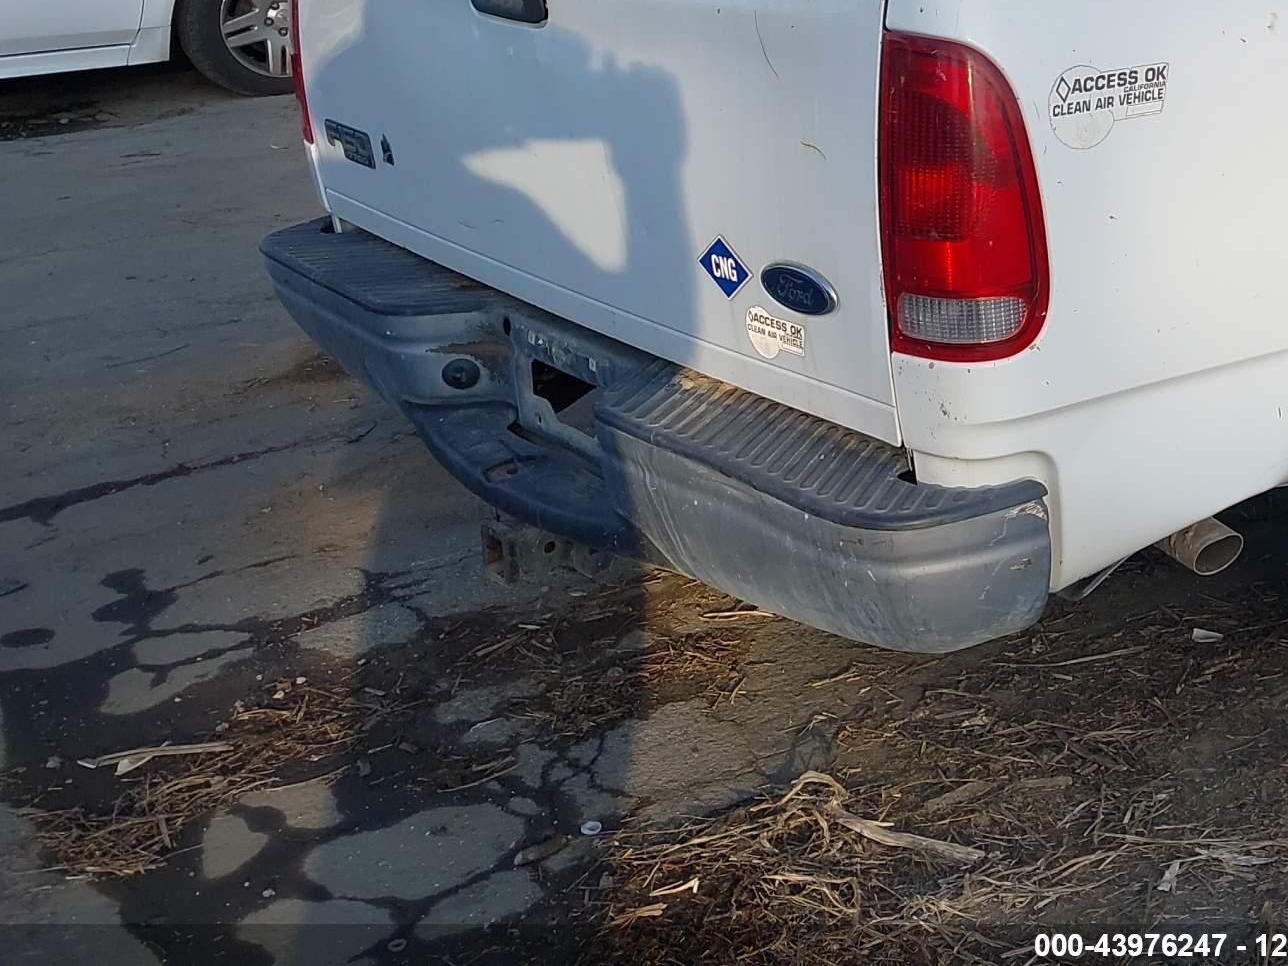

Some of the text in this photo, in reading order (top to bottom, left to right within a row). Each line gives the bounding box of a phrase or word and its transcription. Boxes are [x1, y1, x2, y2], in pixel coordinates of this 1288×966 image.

[1071, 65, 1167, 94] ACCESS OK
[1123, 80, 1166, 93] CALIFORNIA
[1052, 88, 1164, 117] CLEAN AIR VEHICLE
[711, 253, 738, 282] CNG
[775, 273, 815, 306] Ford
[747, 323, 766, 335] CLEAN
[768, 330, 777, 339] AIR
[779, 334, 803, 348] VEHICLE
[753, 312, 787, 332] ACCESS
[790, 325, 802, 337] OK
